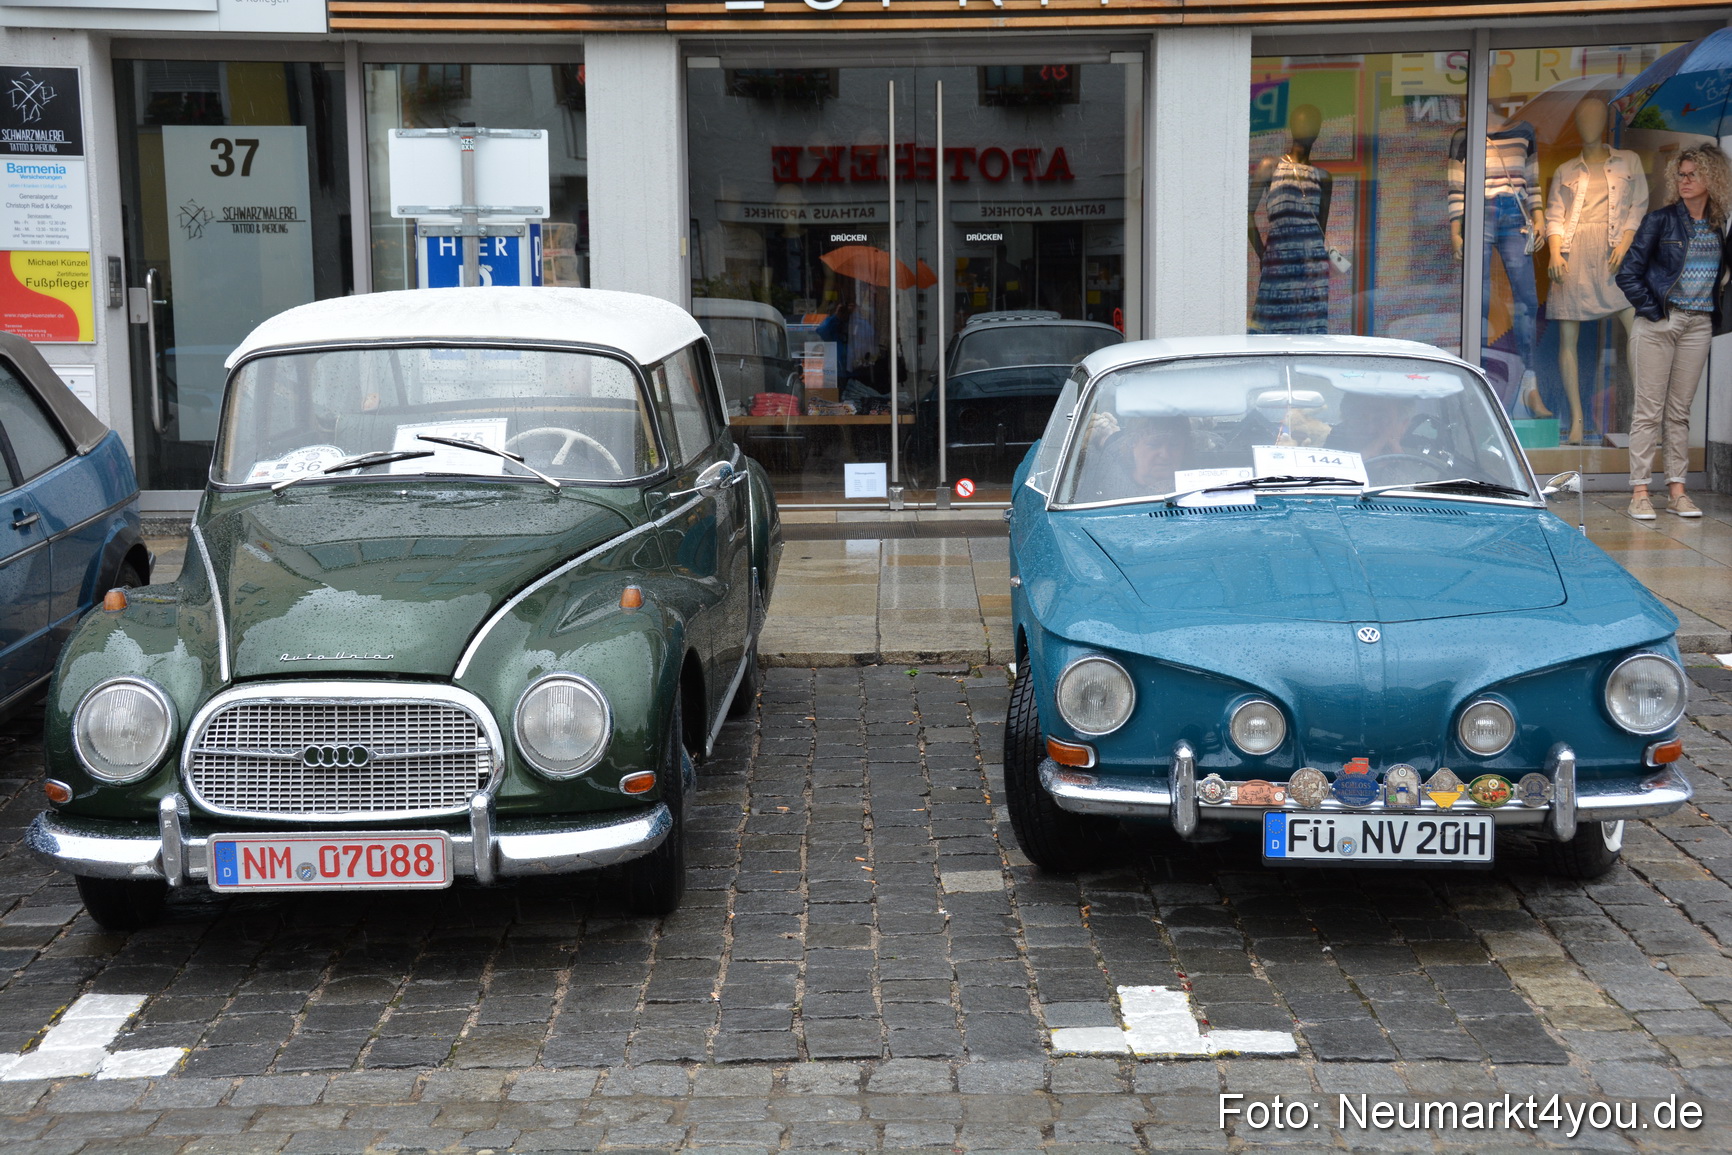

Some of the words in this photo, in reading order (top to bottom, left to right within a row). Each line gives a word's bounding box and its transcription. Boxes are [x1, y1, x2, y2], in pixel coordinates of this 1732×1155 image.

[2, 129, 65, 141] SCHWARZMALEREI
[9, 143, 29, 152] TATTOO
[35, 144, 58, 153] PIERCING
[210, 138, 259, 177] 37
[6, 162, 67, 175] Barmenia
[19, 193, 59, 201] Generalagentur
[5, 202, 31, 210] Christoph
[50, 203, 73, 211] Kollegen
[222, 206, 298, 221] SCHWARZMALEREI
[232, 223, 255, 234] TATTOO
[255, 224, 261, 234] &
[262, 223, 289, 235] PIERCING
[830, 233, 868, 242] DRÜCKEN
[966, 233, 1003, 242] DRÜCKEN
[439, 236, 508, 257] HER
[28, 258, 59, 267] Michael
[60, 258, 88, 267] Künzel
[25, 277, 90, 290] Fußpfleger
[1308, 454, 1343, 466] 144
[290, 460, 323, 474] 36
[279, 653, 325, 663] Auto
[335, 651, 395, 662] Union
[1340, 781, 1371, 789] SCHLOSS
[1272, 839, 1280, 850] D
[1287, 819, 1336, 853] FÜ
[1361, 820, 1409, 854] NV
[1416, 821, 1486, 855] 20H
[223, 867, 231, 878] D
[243, 846, 292, 879] NM
[318, 843, 435, 878] 07088
